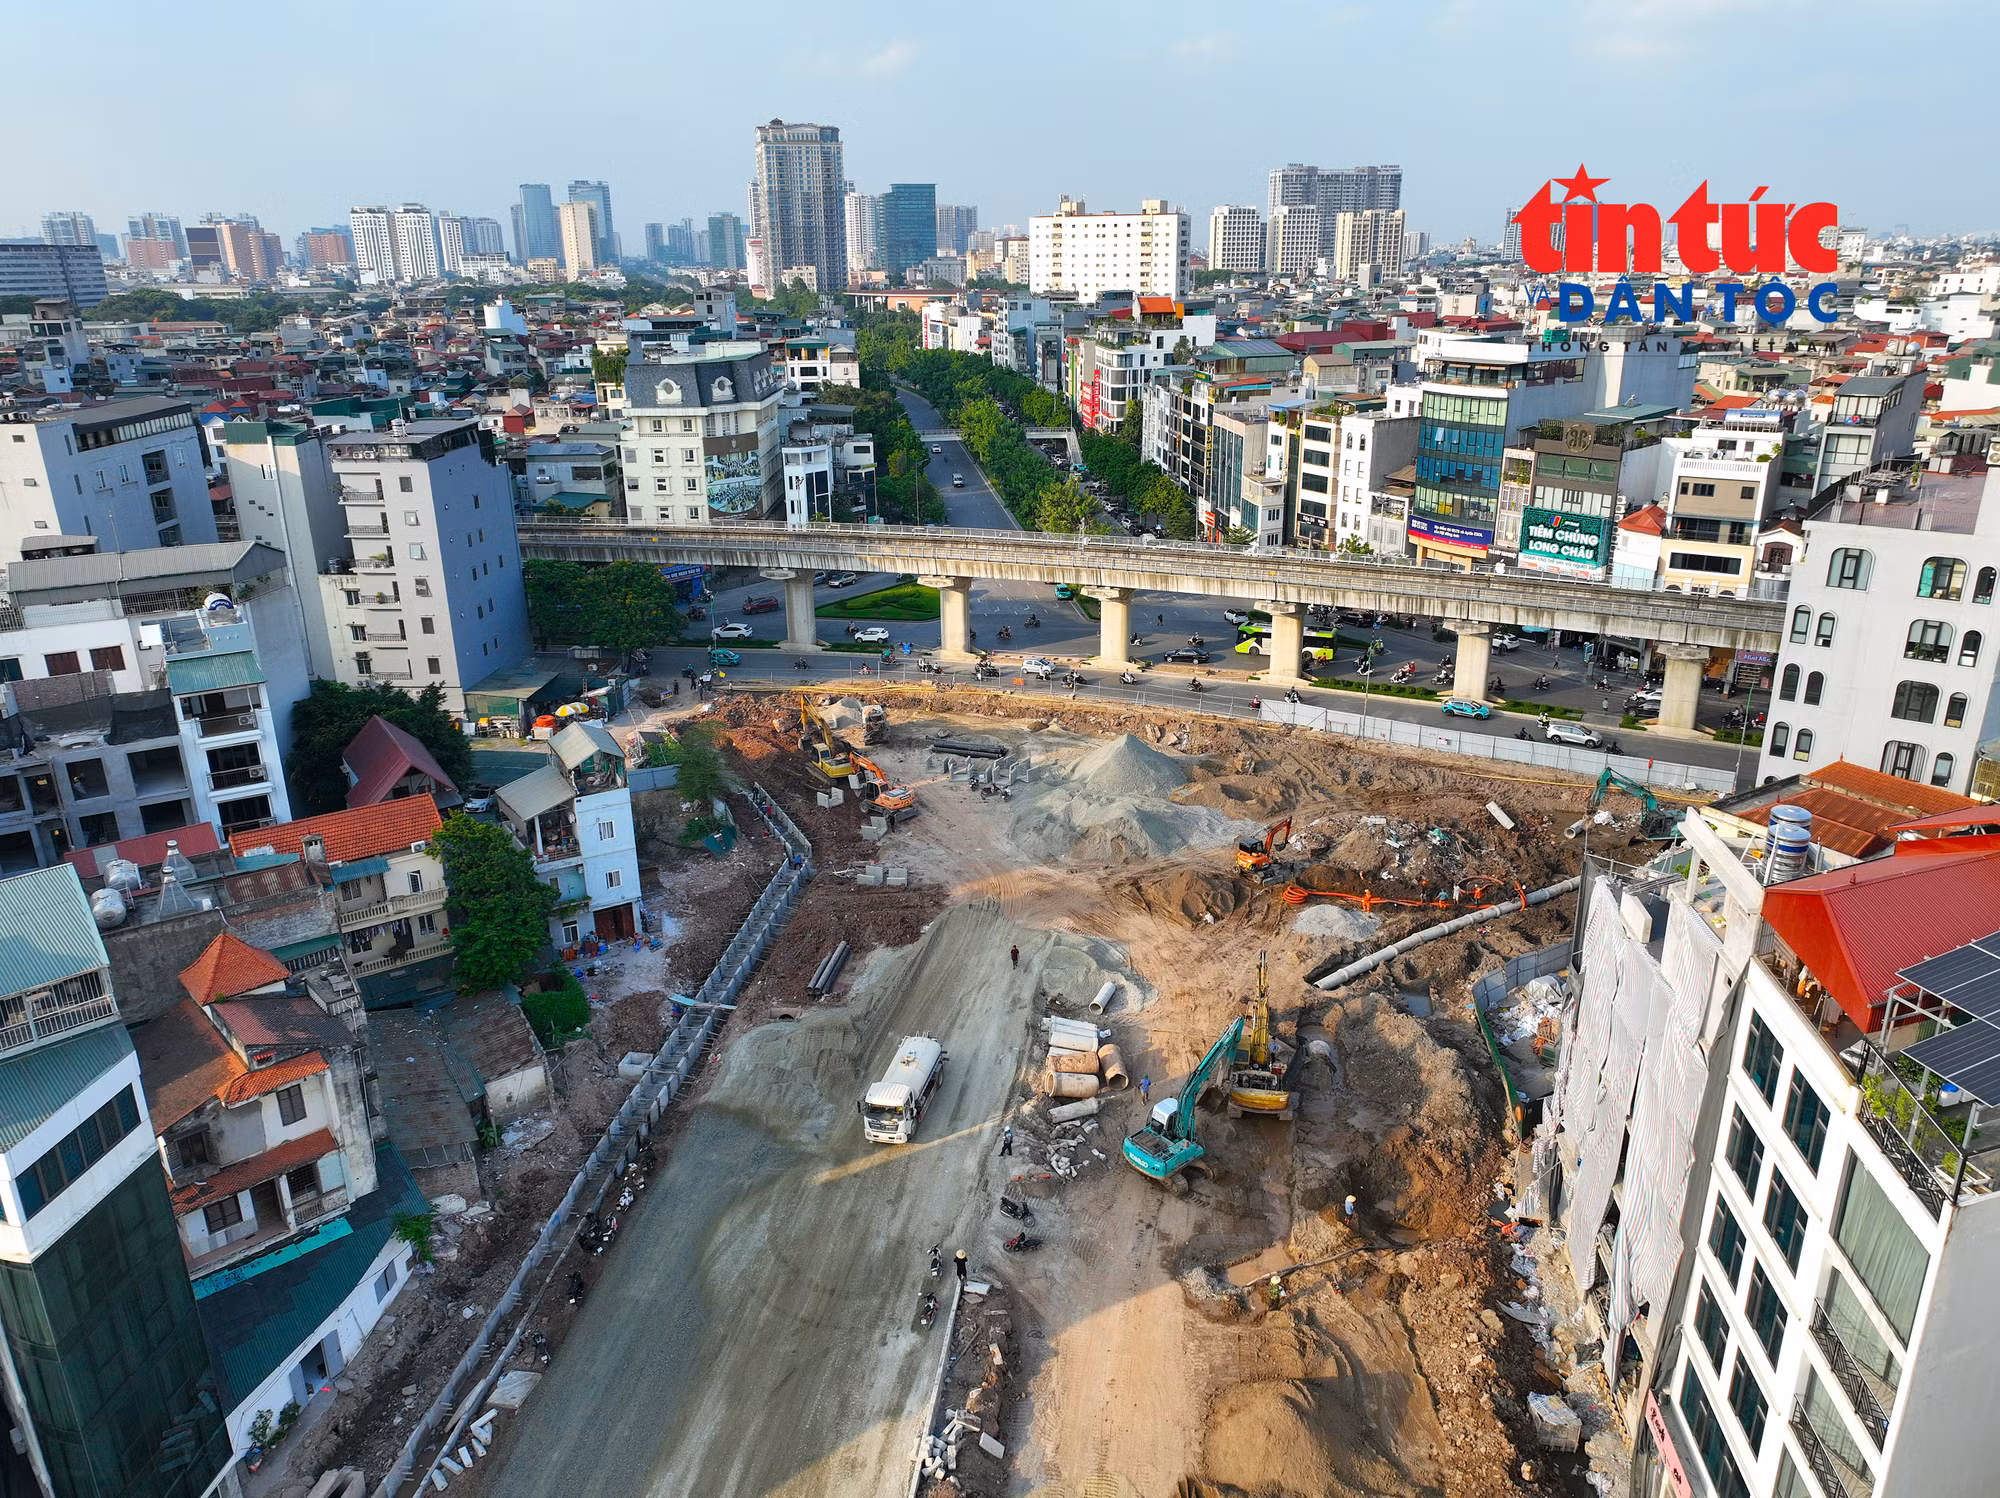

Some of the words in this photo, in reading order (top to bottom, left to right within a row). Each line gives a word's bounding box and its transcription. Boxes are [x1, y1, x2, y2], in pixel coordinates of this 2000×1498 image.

[1528, 524, 1554, 539] TIÊM
[1529, 540, 1559, 554] LONG
[1561, 544, 1594, 559] CHÂU
